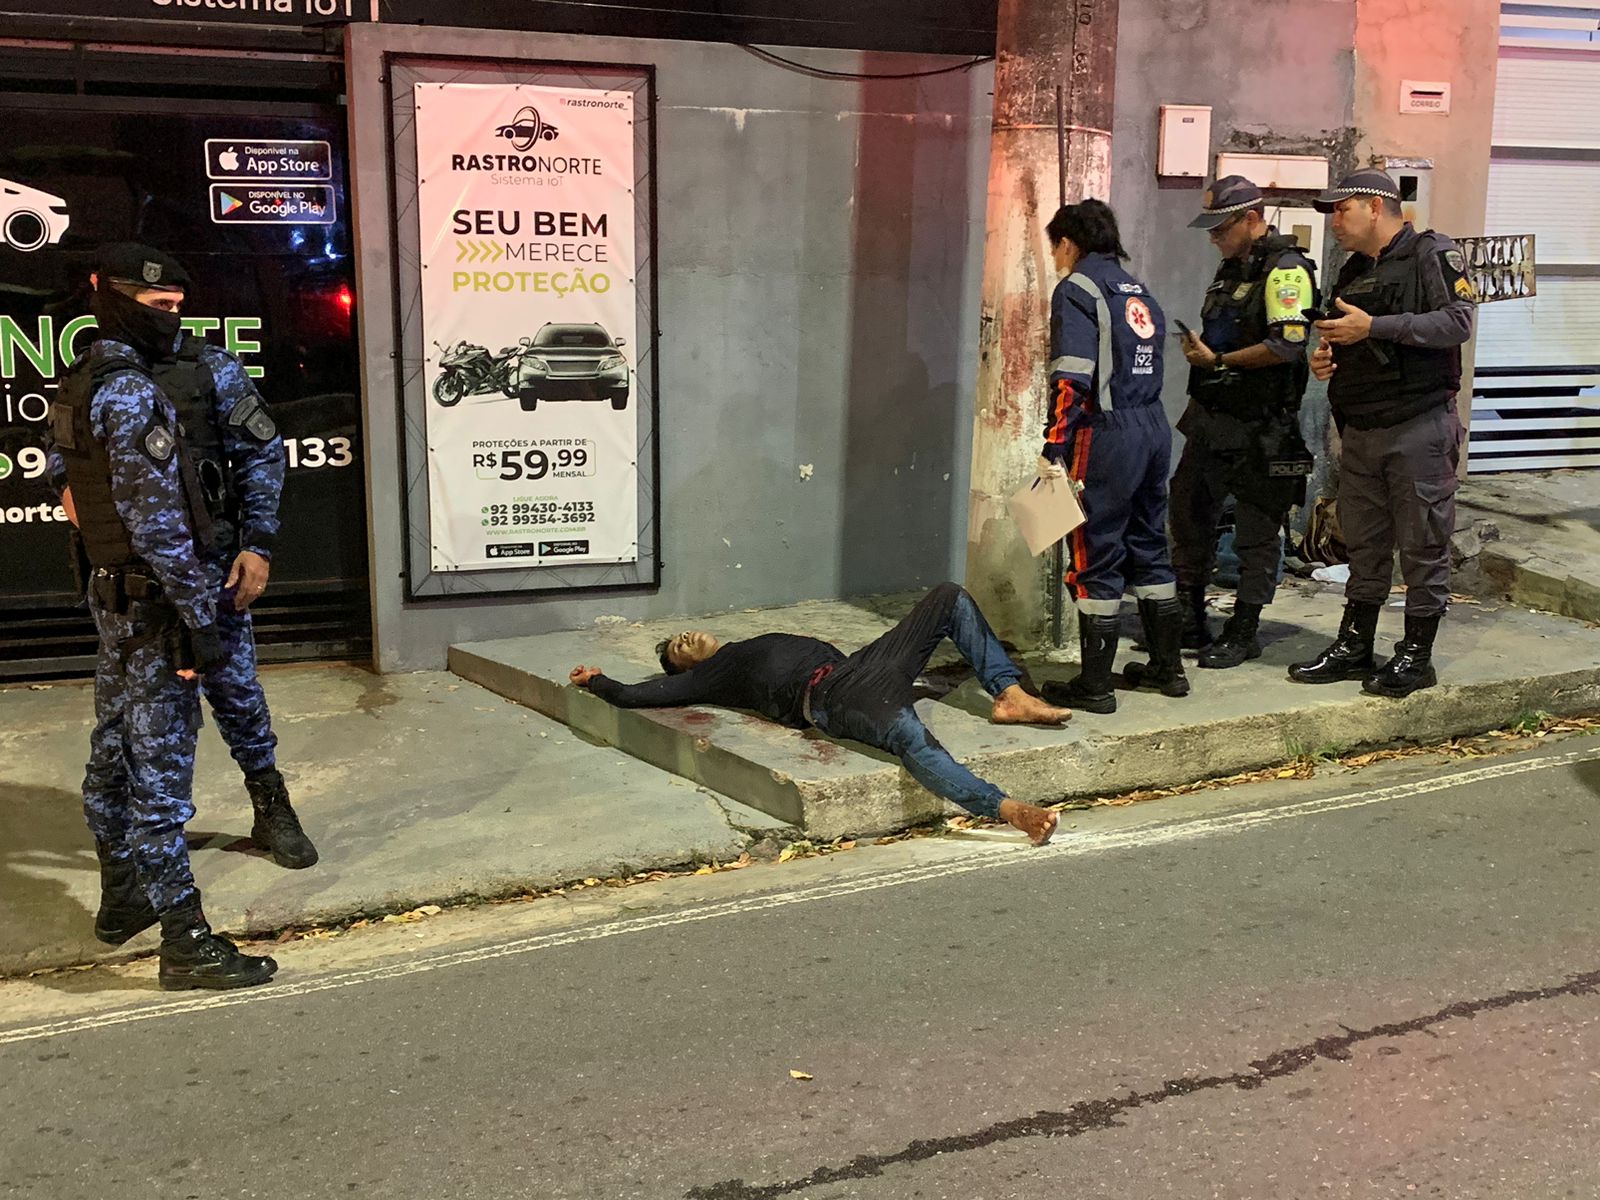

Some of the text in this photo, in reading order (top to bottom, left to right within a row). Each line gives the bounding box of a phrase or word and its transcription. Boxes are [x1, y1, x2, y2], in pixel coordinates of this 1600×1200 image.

[246, 157, 320, 174] App Store
[452, 154, 602, 175] RASTRONORTE
[491, 173, 543, 186] Sistema
[248, 190, 305, 199] DISPONÍVEL NO
[249, 200, 326, 217] Google Play
[452, 210, 608, 237] SEU BEM
[506, 242, 608, 262] MERECE
[453, 268, 610, 298] PROTEÇÃO
[1134, 354, 1153, 366] 192
[472, 439, 529, 449] PROTEÇÕES
[539, 439, 573, 447] PARTIR
[574, 438, 588, 446] DE
[490, 501, 594, 515] 92 99430-4133
[490, 512, 595, 526] 92 99354-3692
